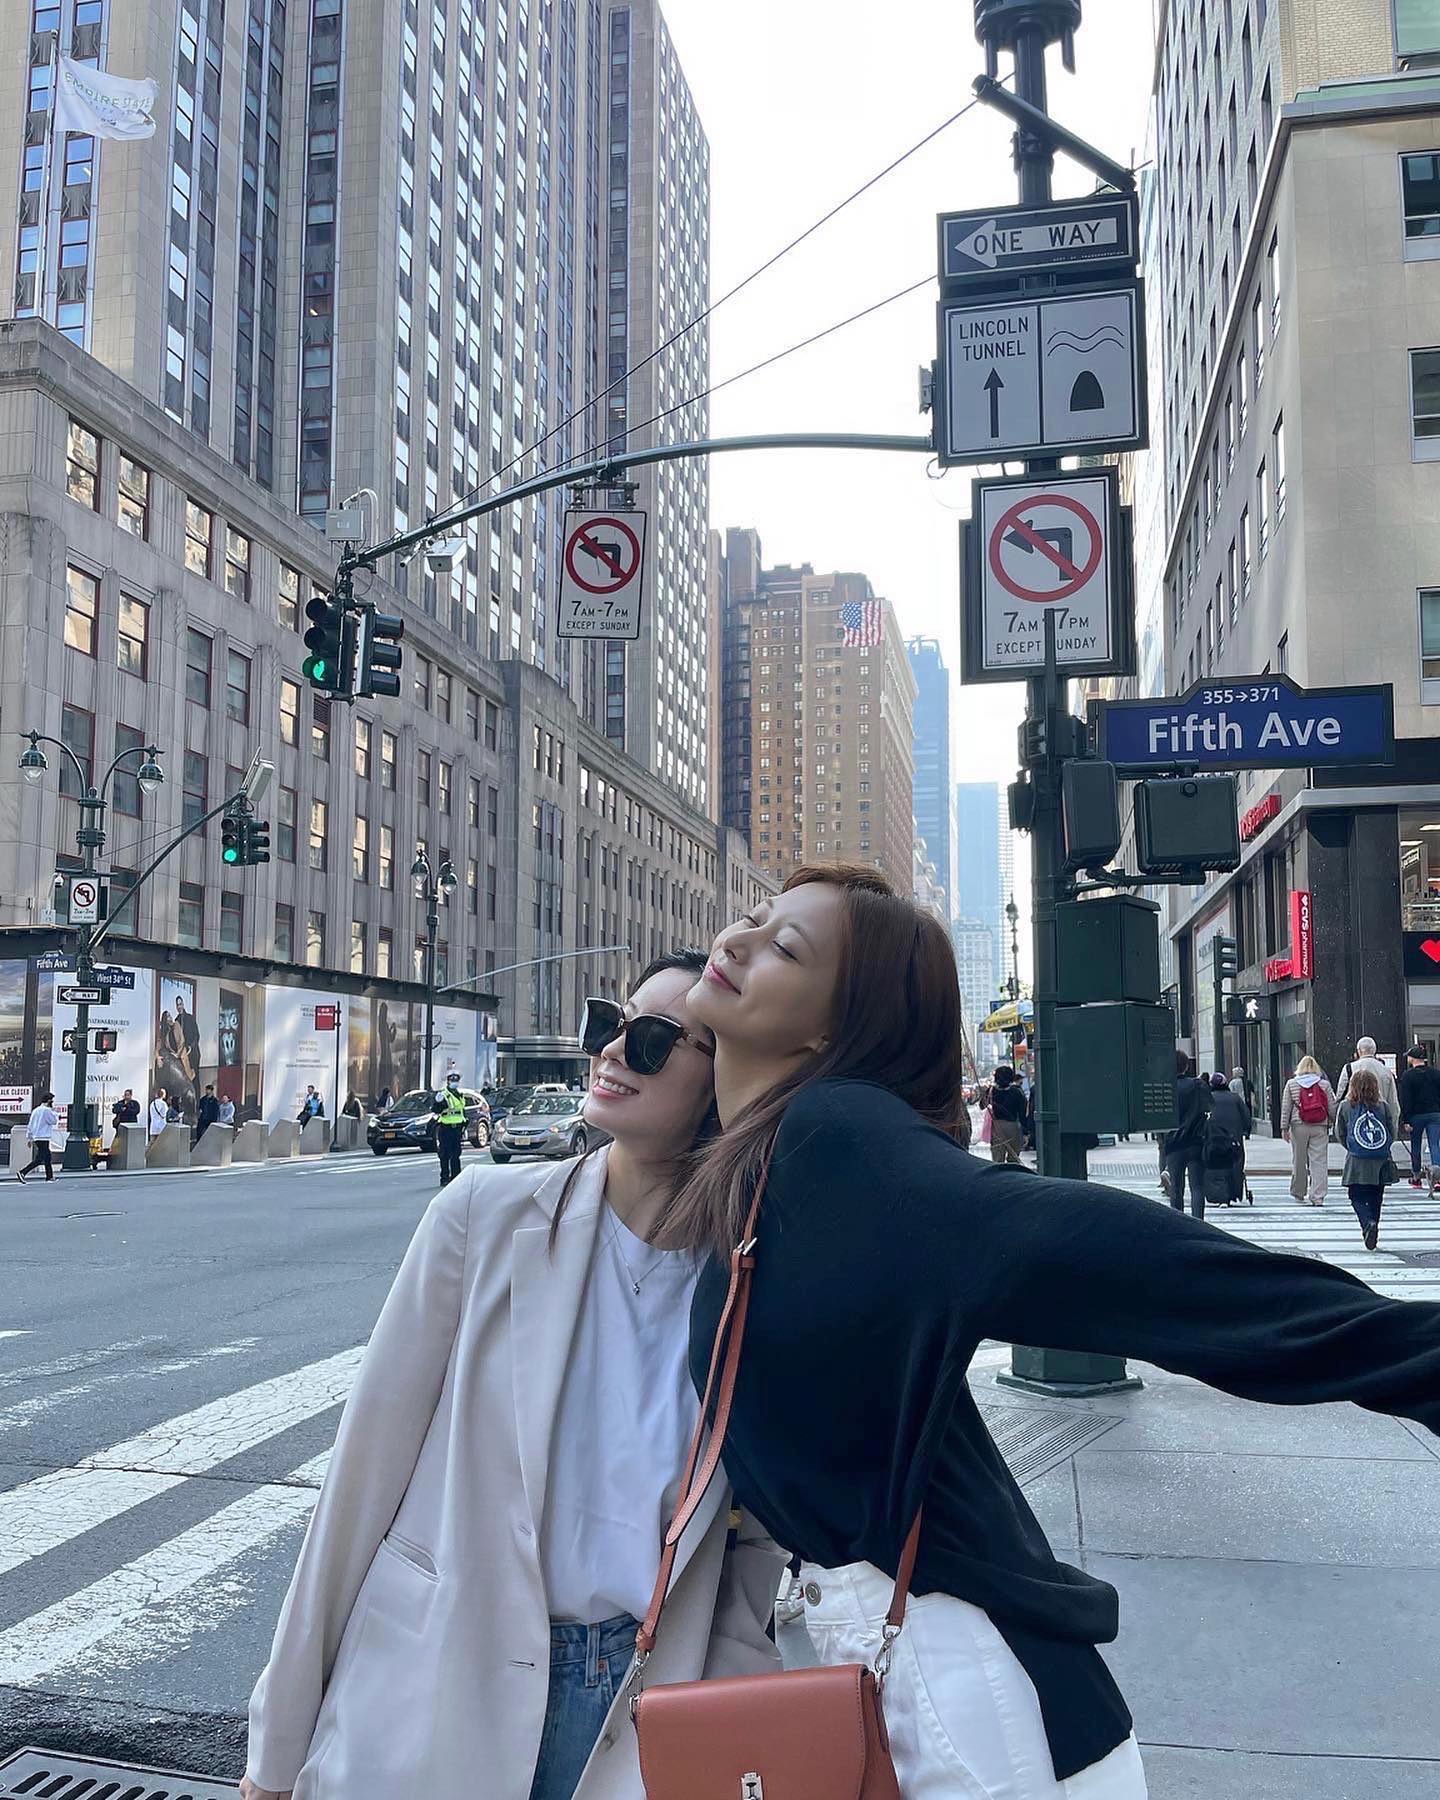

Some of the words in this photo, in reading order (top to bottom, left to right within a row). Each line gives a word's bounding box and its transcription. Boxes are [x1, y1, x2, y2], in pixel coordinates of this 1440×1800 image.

[974, 230, 1023, 255] ONE
[1048, 222, 1101, 247] WAY
[960, 317, 1028, 339] LINCOLN
[963, 340, 1026, 361] TUNNEL
[567, 620, 595, 630] EXCEPT
[600, 621, 630, 631] SUNDAY
[997, 641, 1042, 655] EXCEPT
[1055, 636, 1096, 651] UNDAY
[1149, 712, 1242, 753] Fifth
[1257, 712, 1341, 748] Ave
[1301, 906, 1310, 931] CVS
[1301, 931, 1309, 976] pharmacy
